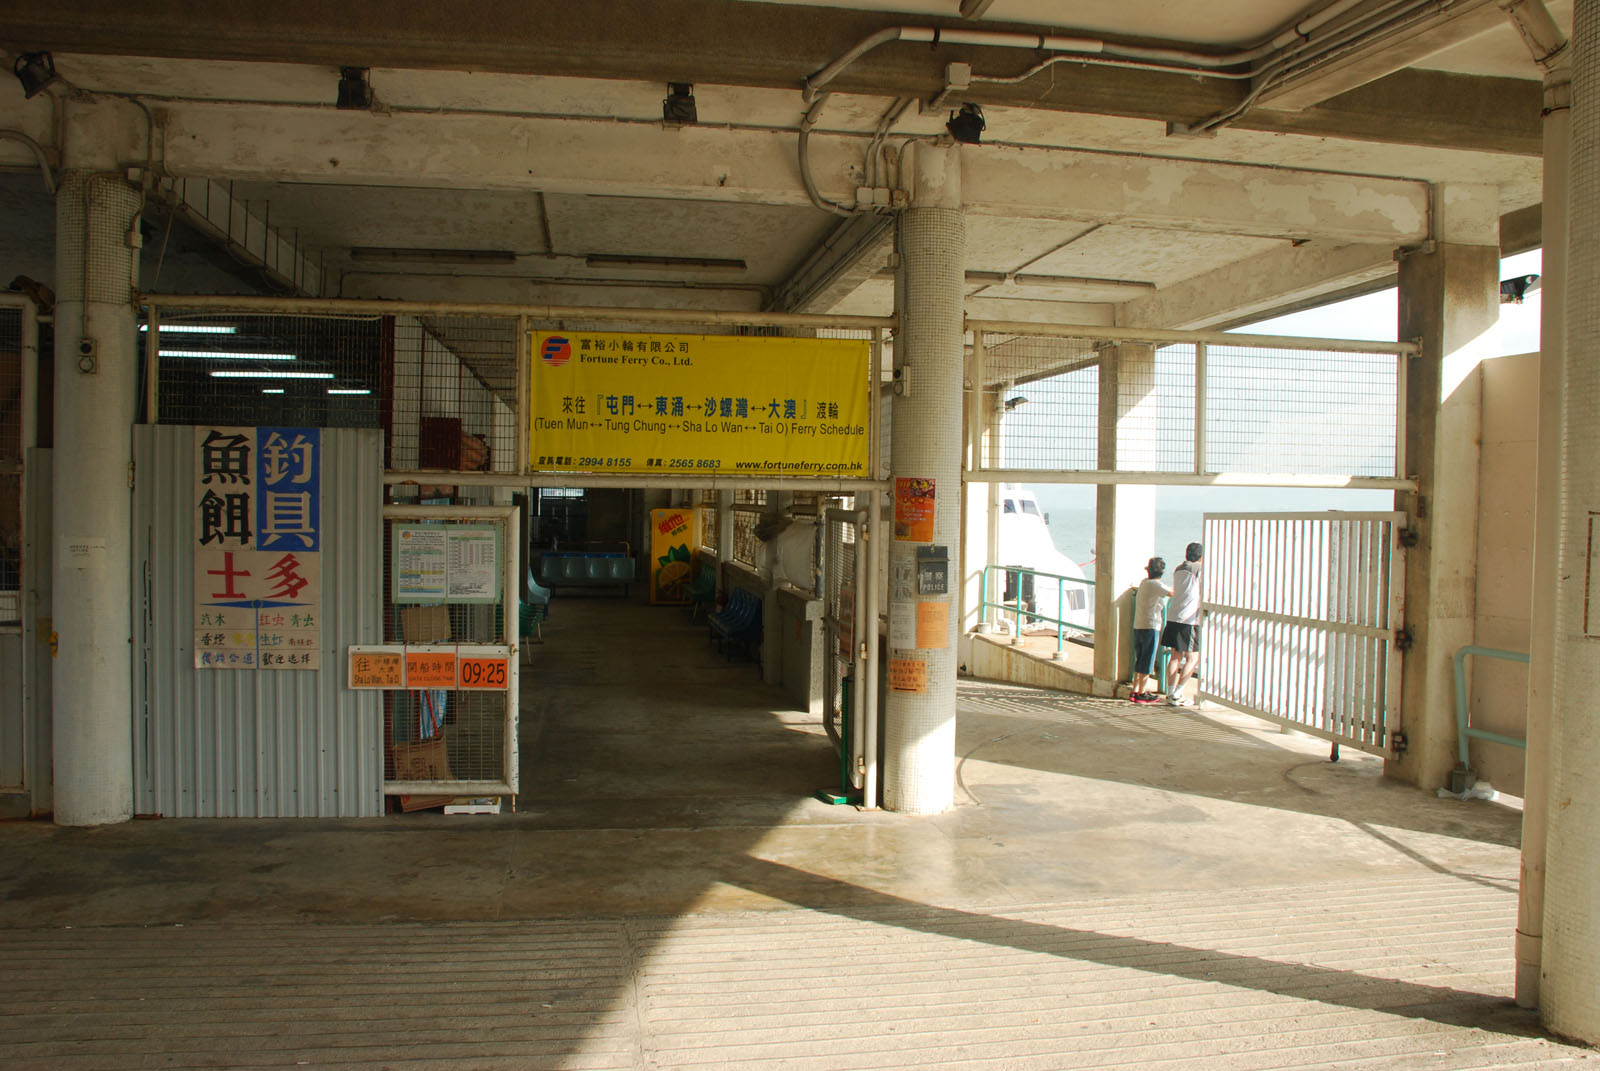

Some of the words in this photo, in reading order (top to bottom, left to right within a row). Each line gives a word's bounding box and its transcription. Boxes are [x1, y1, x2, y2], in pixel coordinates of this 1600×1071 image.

[580, 338, 689, 354] 富裕小輪有限公司
[580, 354, 619, 364] Fortune
[622, 355, 649, 367] Ferry
[651, 355, 670, 366] Co.,
[673, 355, 693, 366] Ltd.
[562, 396, 586, 414] 來往
[655, 395, 684, 417] 東涌
[704, 397, 748, 419] 沙螺灣
[816, 401, 840, 420] 渡輪
[534, 418, 563, 431] (Tuen
[567, 419, 589, 430] Mun
[605, 420, 630, 434] Tung
[633, 420, 666, 434] Chung
[683, 421, 702, 433] Sha
[706, 421, 718, 433] Lo
[720, 421, 743, 433] Wan
[759, 422, 773, 434] Tai
[776, 422, 788, 436] O)
[791, 423, 816, 437] Ferry
[820, 423, 864, 435] Schedule
[578, 457, 604, 467] 2994
[606, 457, 632, 467] 8155
[669, 458, 695, 468] 2565
[697, 459, 721, 468] 8683
[736, 459, 863, 472] www.fortuneferry.com.hk
[198, 430, 252, 546] 魚餌
[262, 432, 315, 548] 釣具
[208, 552, 309, 598] 士多
[356, 658, 370, 672] 往
[462, 662, 505, 684] 09:25
